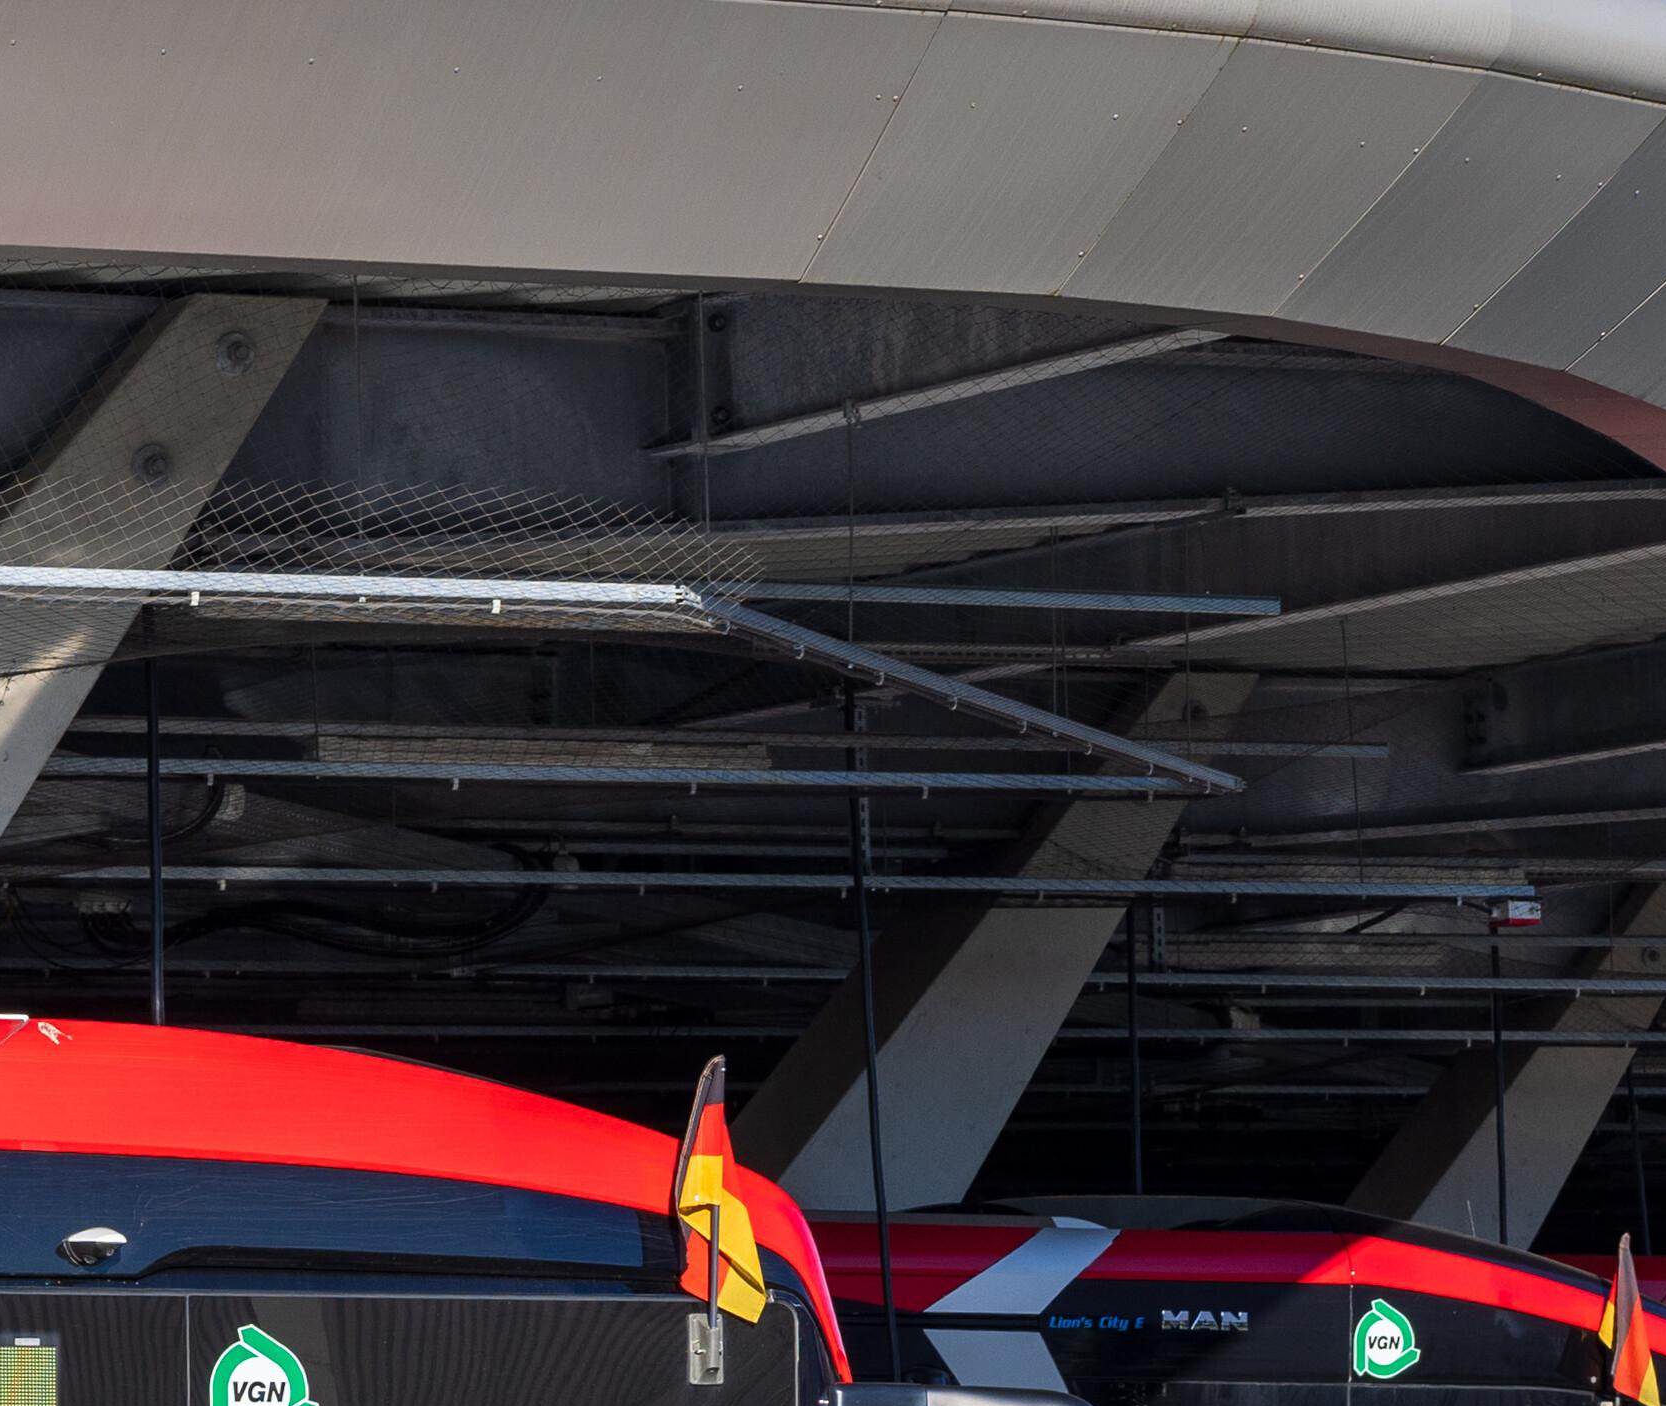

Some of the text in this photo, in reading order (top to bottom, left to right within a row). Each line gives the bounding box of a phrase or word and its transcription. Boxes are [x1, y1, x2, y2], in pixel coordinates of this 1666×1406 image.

[1049, 1316, 1145, 1331] Lion's City E
[1161, 1310, 1249, 1331] MAN
[1368, 1335, 1400, 1350] VGN
[233, 1381, 286, 1402] VGN
